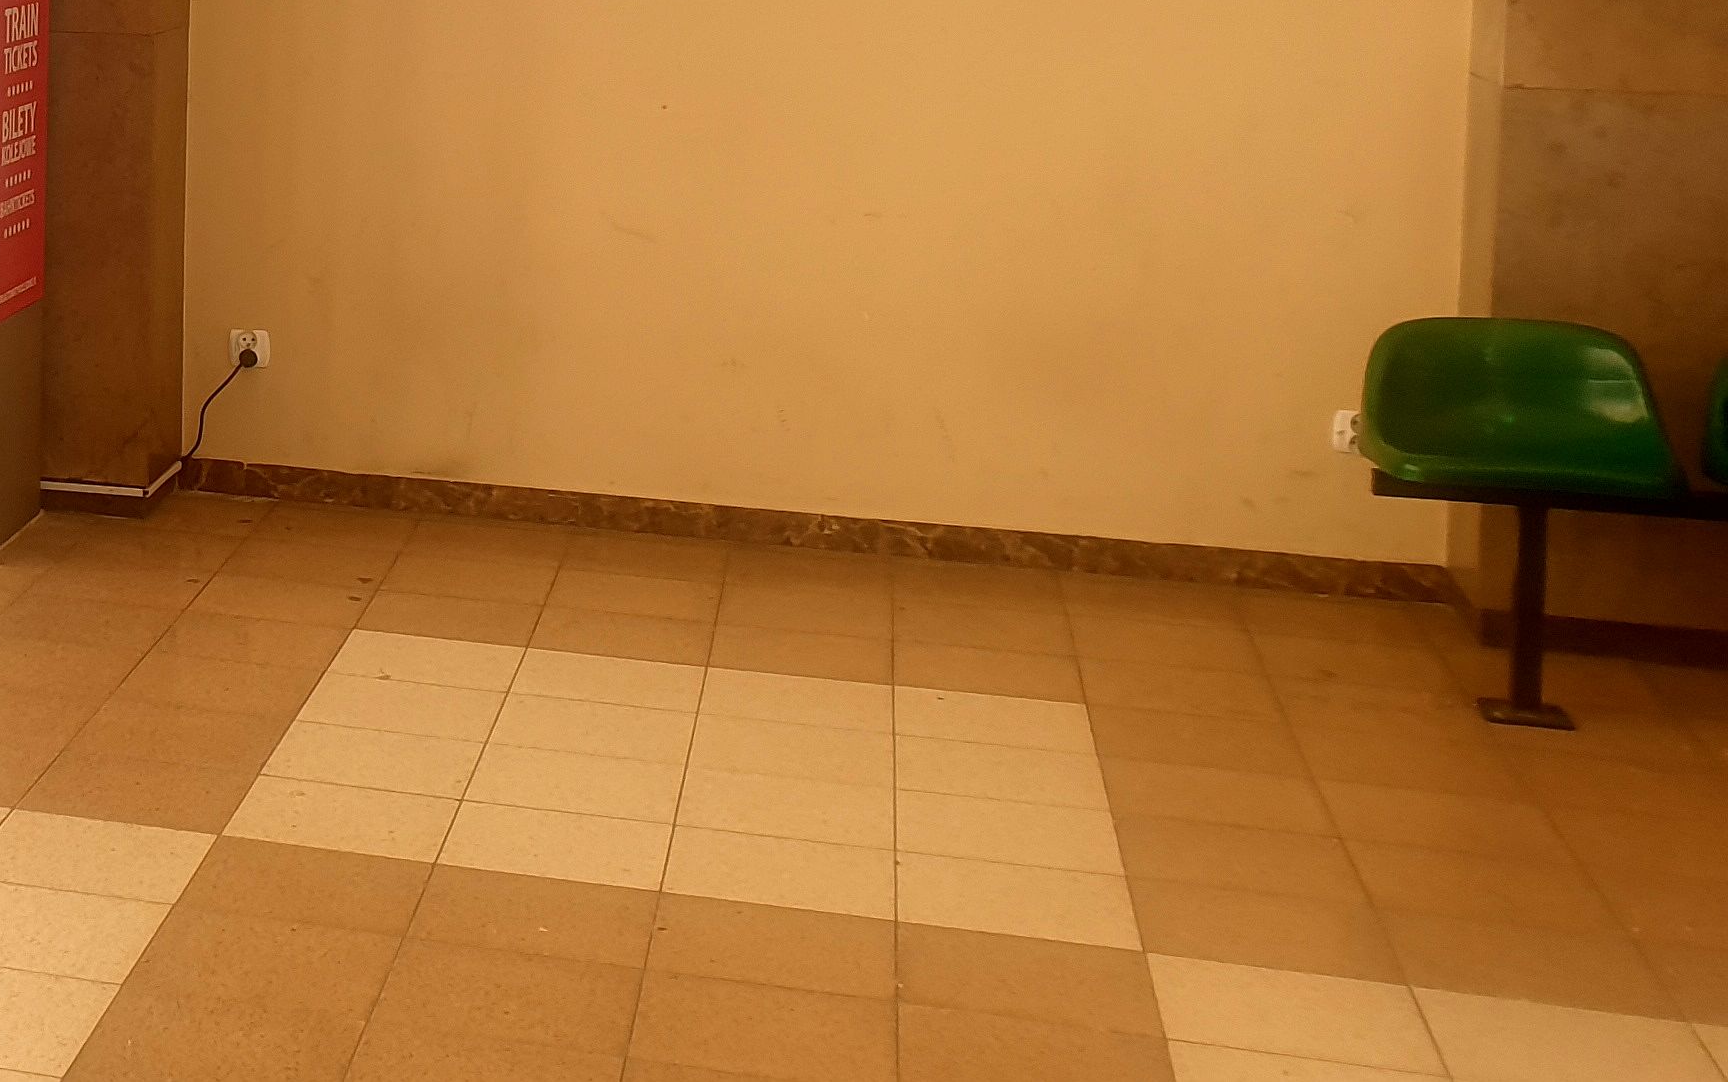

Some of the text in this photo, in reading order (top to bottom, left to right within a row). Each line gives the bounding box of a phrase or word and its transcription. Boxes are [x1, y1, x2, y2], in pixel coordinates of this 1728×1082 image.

[5, 2, 39, 44] TRAIN
[3, 40, 38, 74] TICKETS
[2, 101, 37, 143] BILETY
